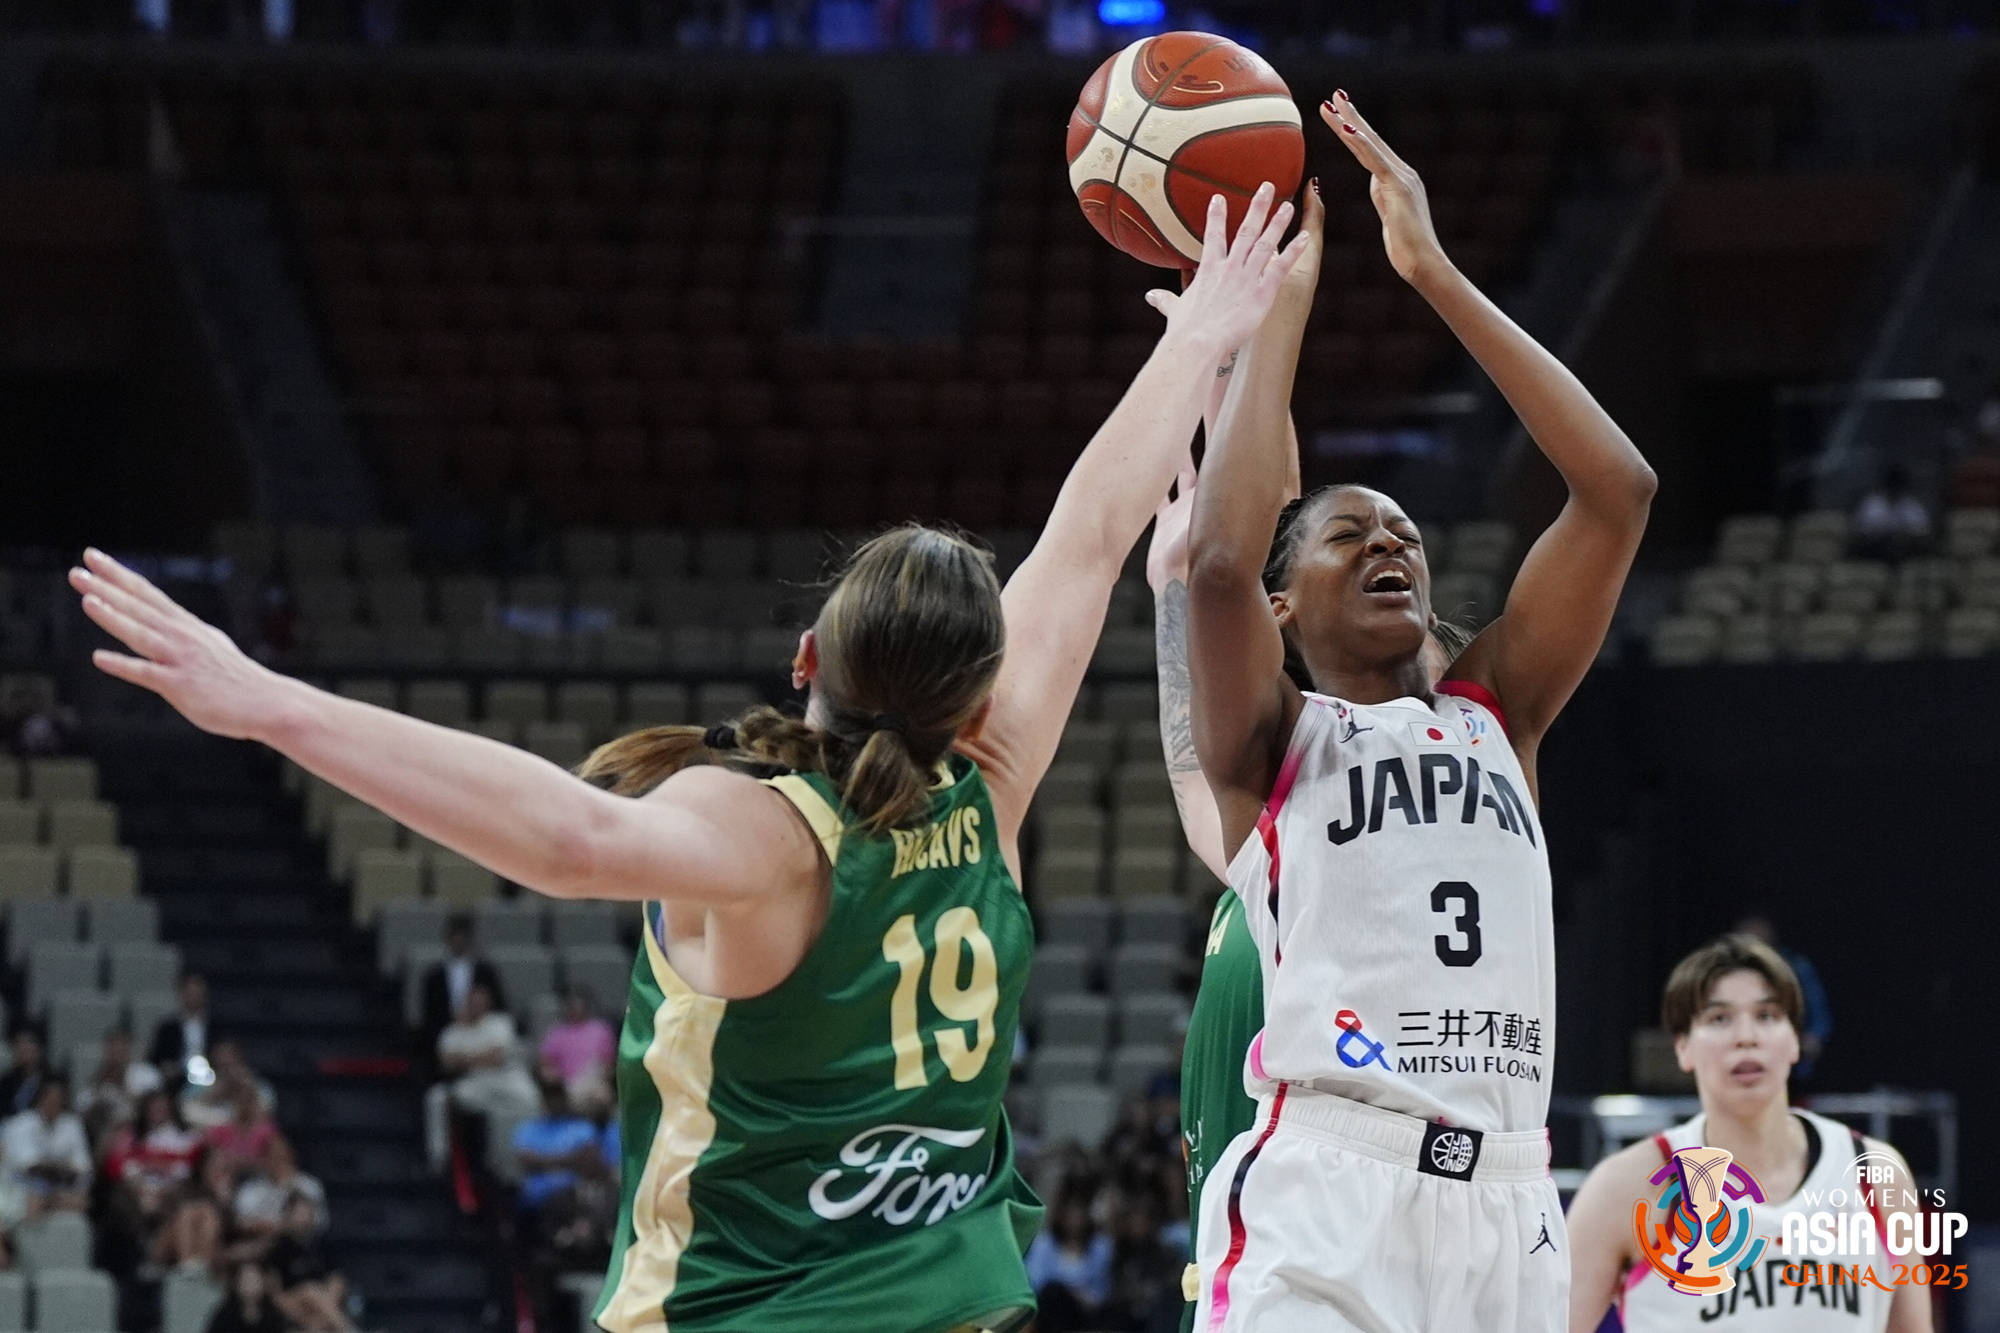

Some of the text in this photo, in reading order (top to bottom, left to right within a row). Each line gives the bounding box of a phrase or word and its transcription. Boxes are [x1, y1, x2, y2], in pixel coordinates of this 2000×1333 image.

[1327, 753, 1537, 850] JAPAN
[1431, 881, 1482, 967] 3
[882, 906, 998, 1091] 19
[1397, 1009, 1542, 1056] 三井不動産
[1397, 1055, 1476, 1073] MITSUI
